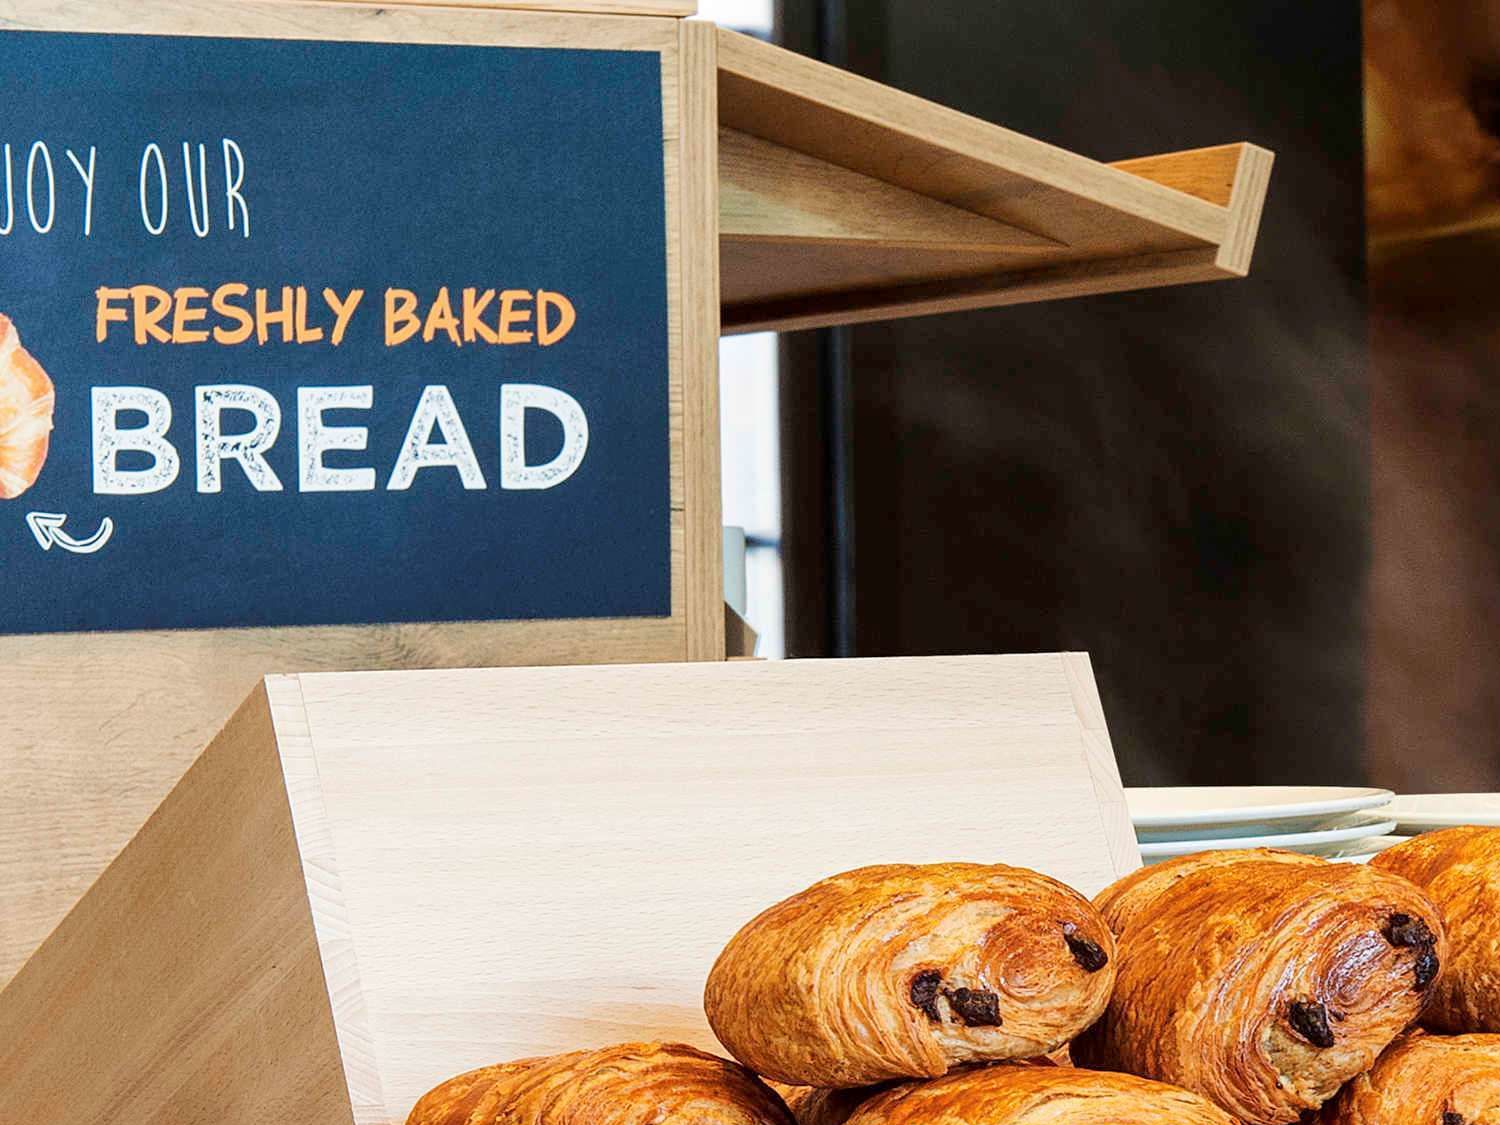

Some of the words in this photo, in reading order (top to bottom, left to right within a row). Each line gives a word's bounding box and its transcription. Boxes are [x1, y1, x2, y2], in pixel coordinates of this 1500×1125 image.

[0, 141, 96, 235] JOY
[139, 138, 250, 238] OUR
[95, 284, 364, 345] FRESHLY
[383, 287, 576, 347] BAKED
[91, 384, 589, 495] BREAD
